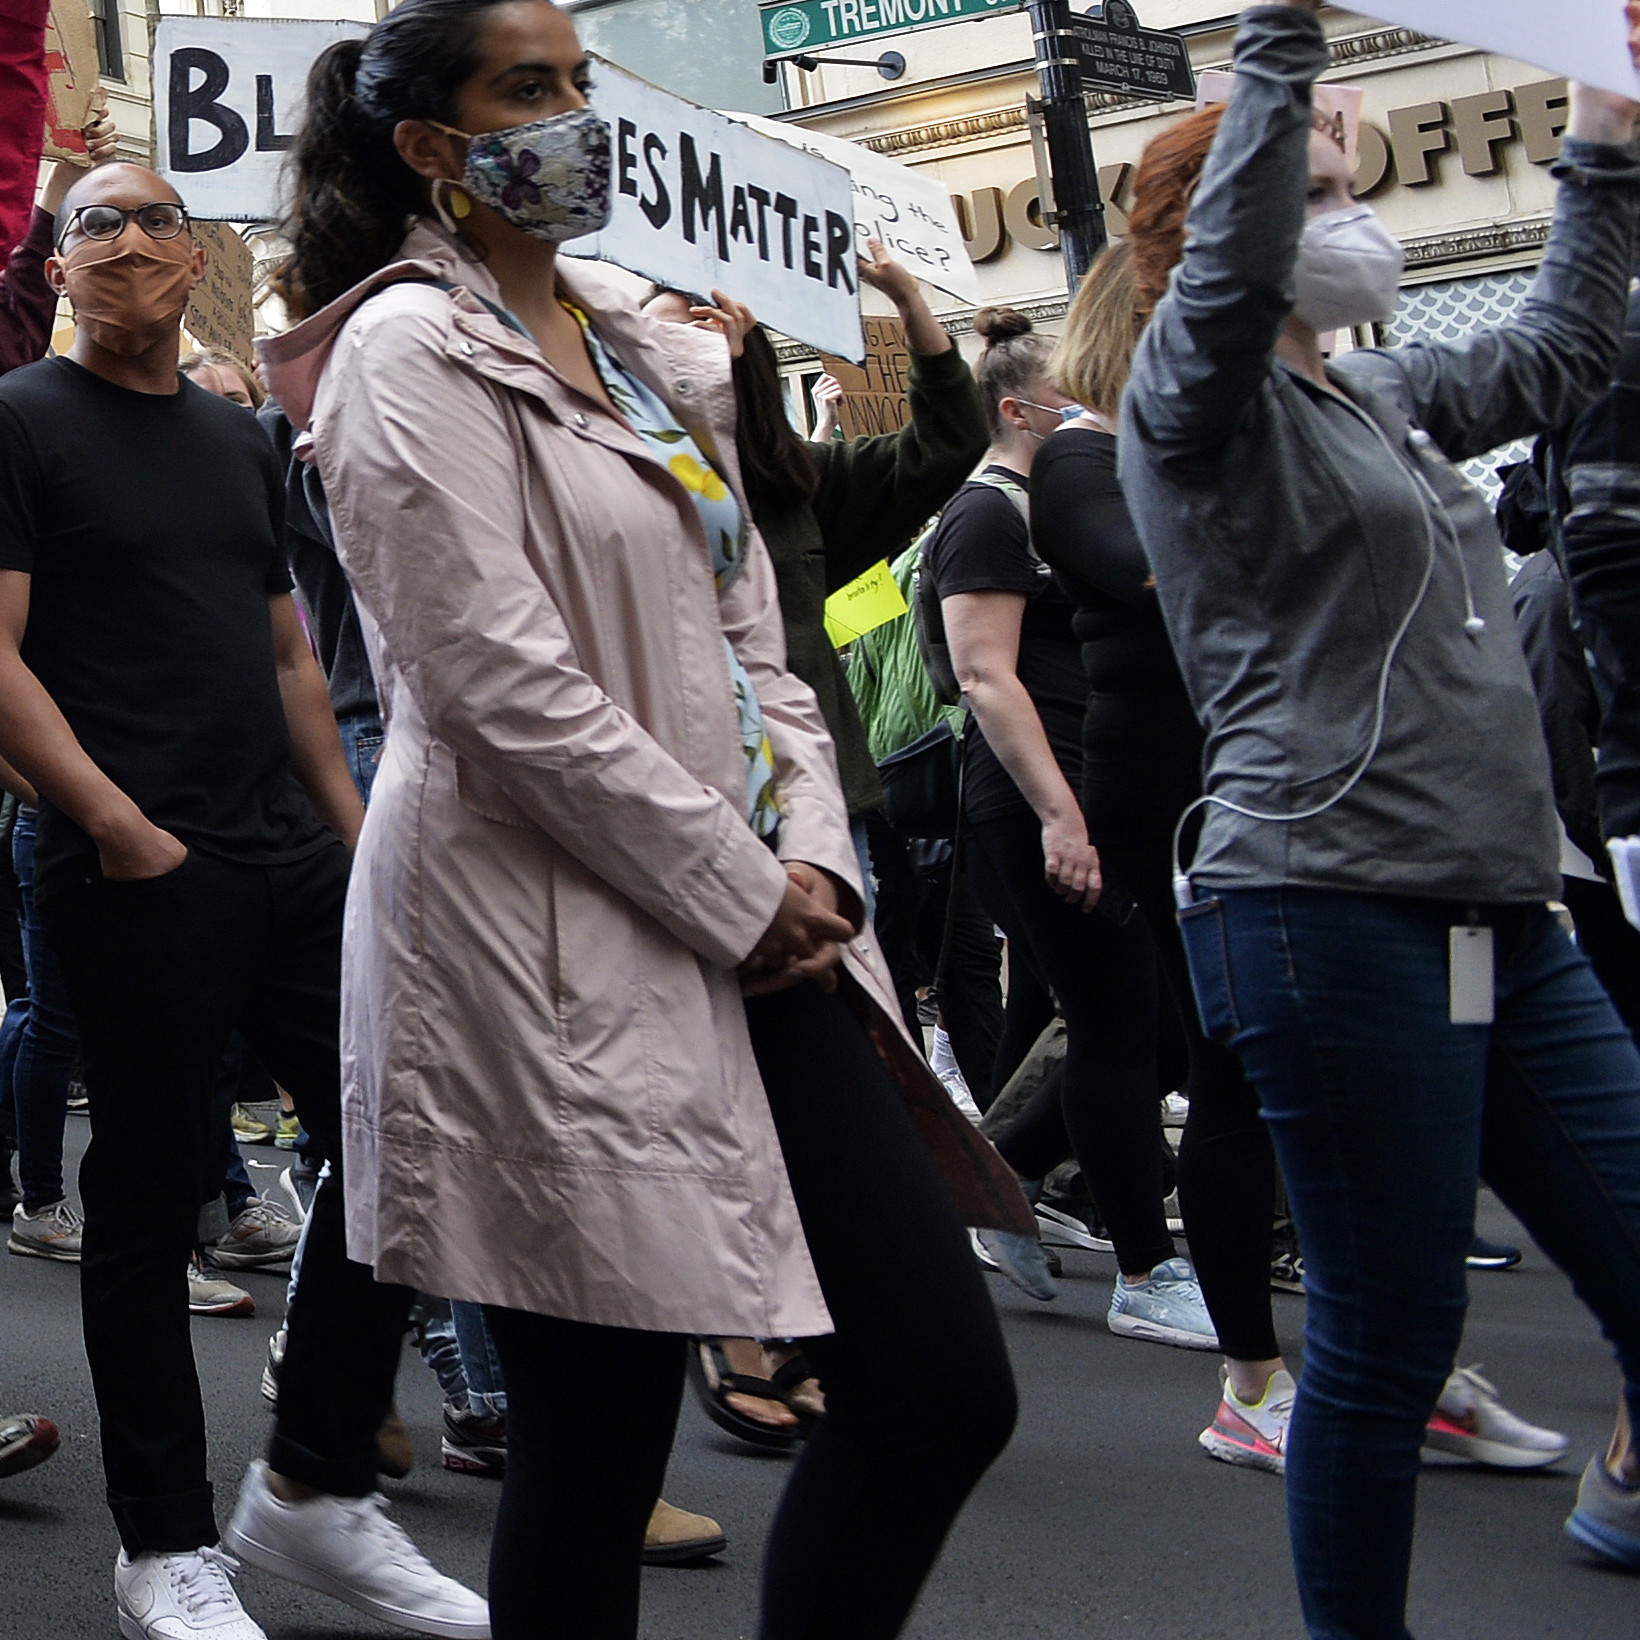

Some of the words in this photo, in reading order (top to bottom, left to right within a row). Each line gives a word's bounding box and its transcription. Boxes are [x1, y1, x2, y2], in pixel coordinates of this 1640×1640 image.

[679, 130, 855, 296] MATTER
[907, 202, 949, 234] the
[854, 220, 952, 272] olice?
[865, 353, 908, 394] THE
